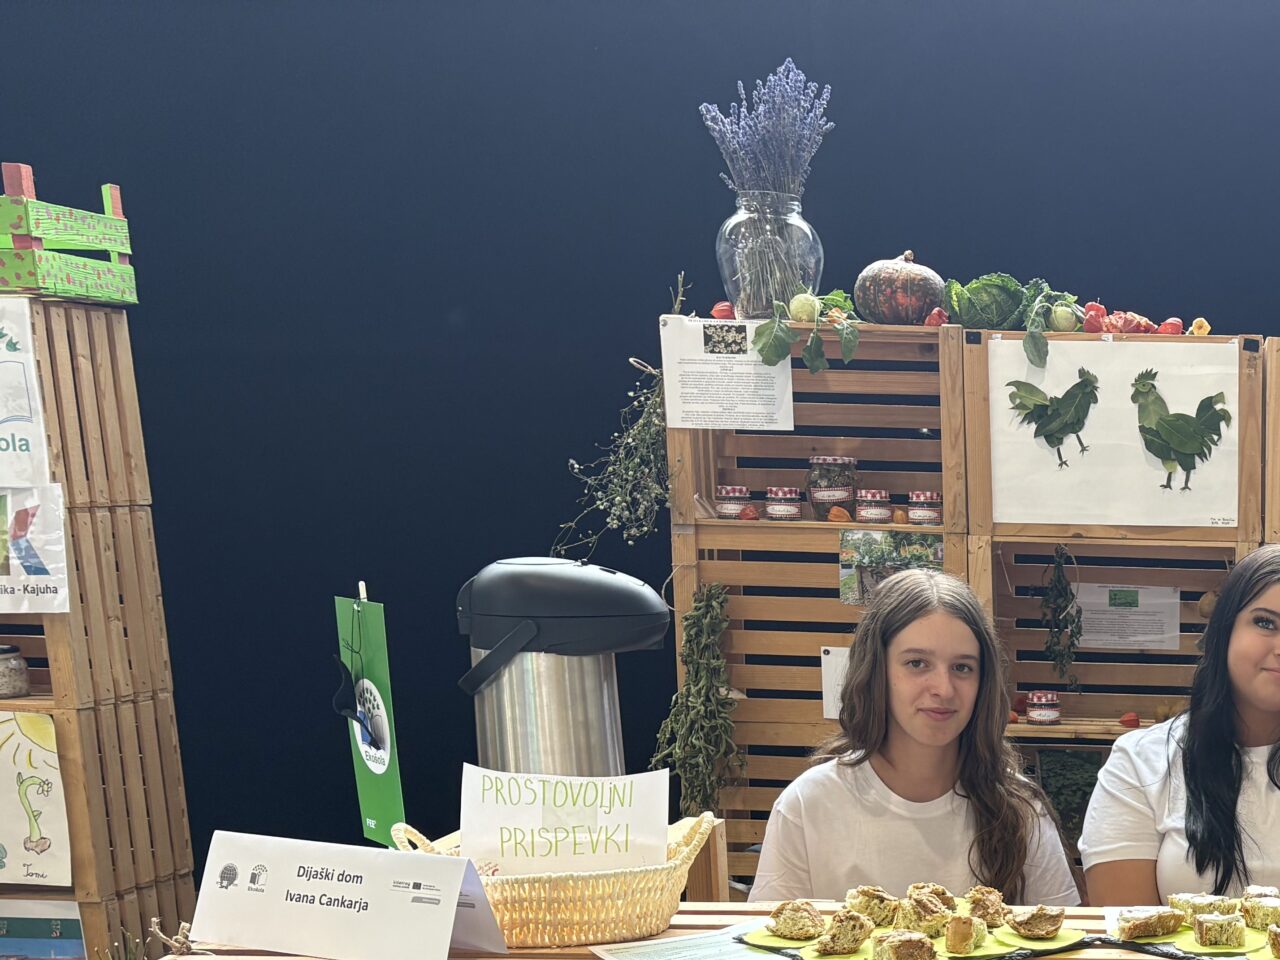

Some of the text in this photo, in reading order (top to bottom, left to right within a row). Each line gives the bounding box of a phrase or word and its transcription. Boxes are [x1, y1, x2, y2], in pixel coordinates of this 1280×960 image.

[23, 584, 58, 596] Kajuha
[500, 824, 629, 857] PRISPEVKI
[297, 866, 363, 884] Dijaški dom
[285, 889, 368, 913] Ivana Cankarja
